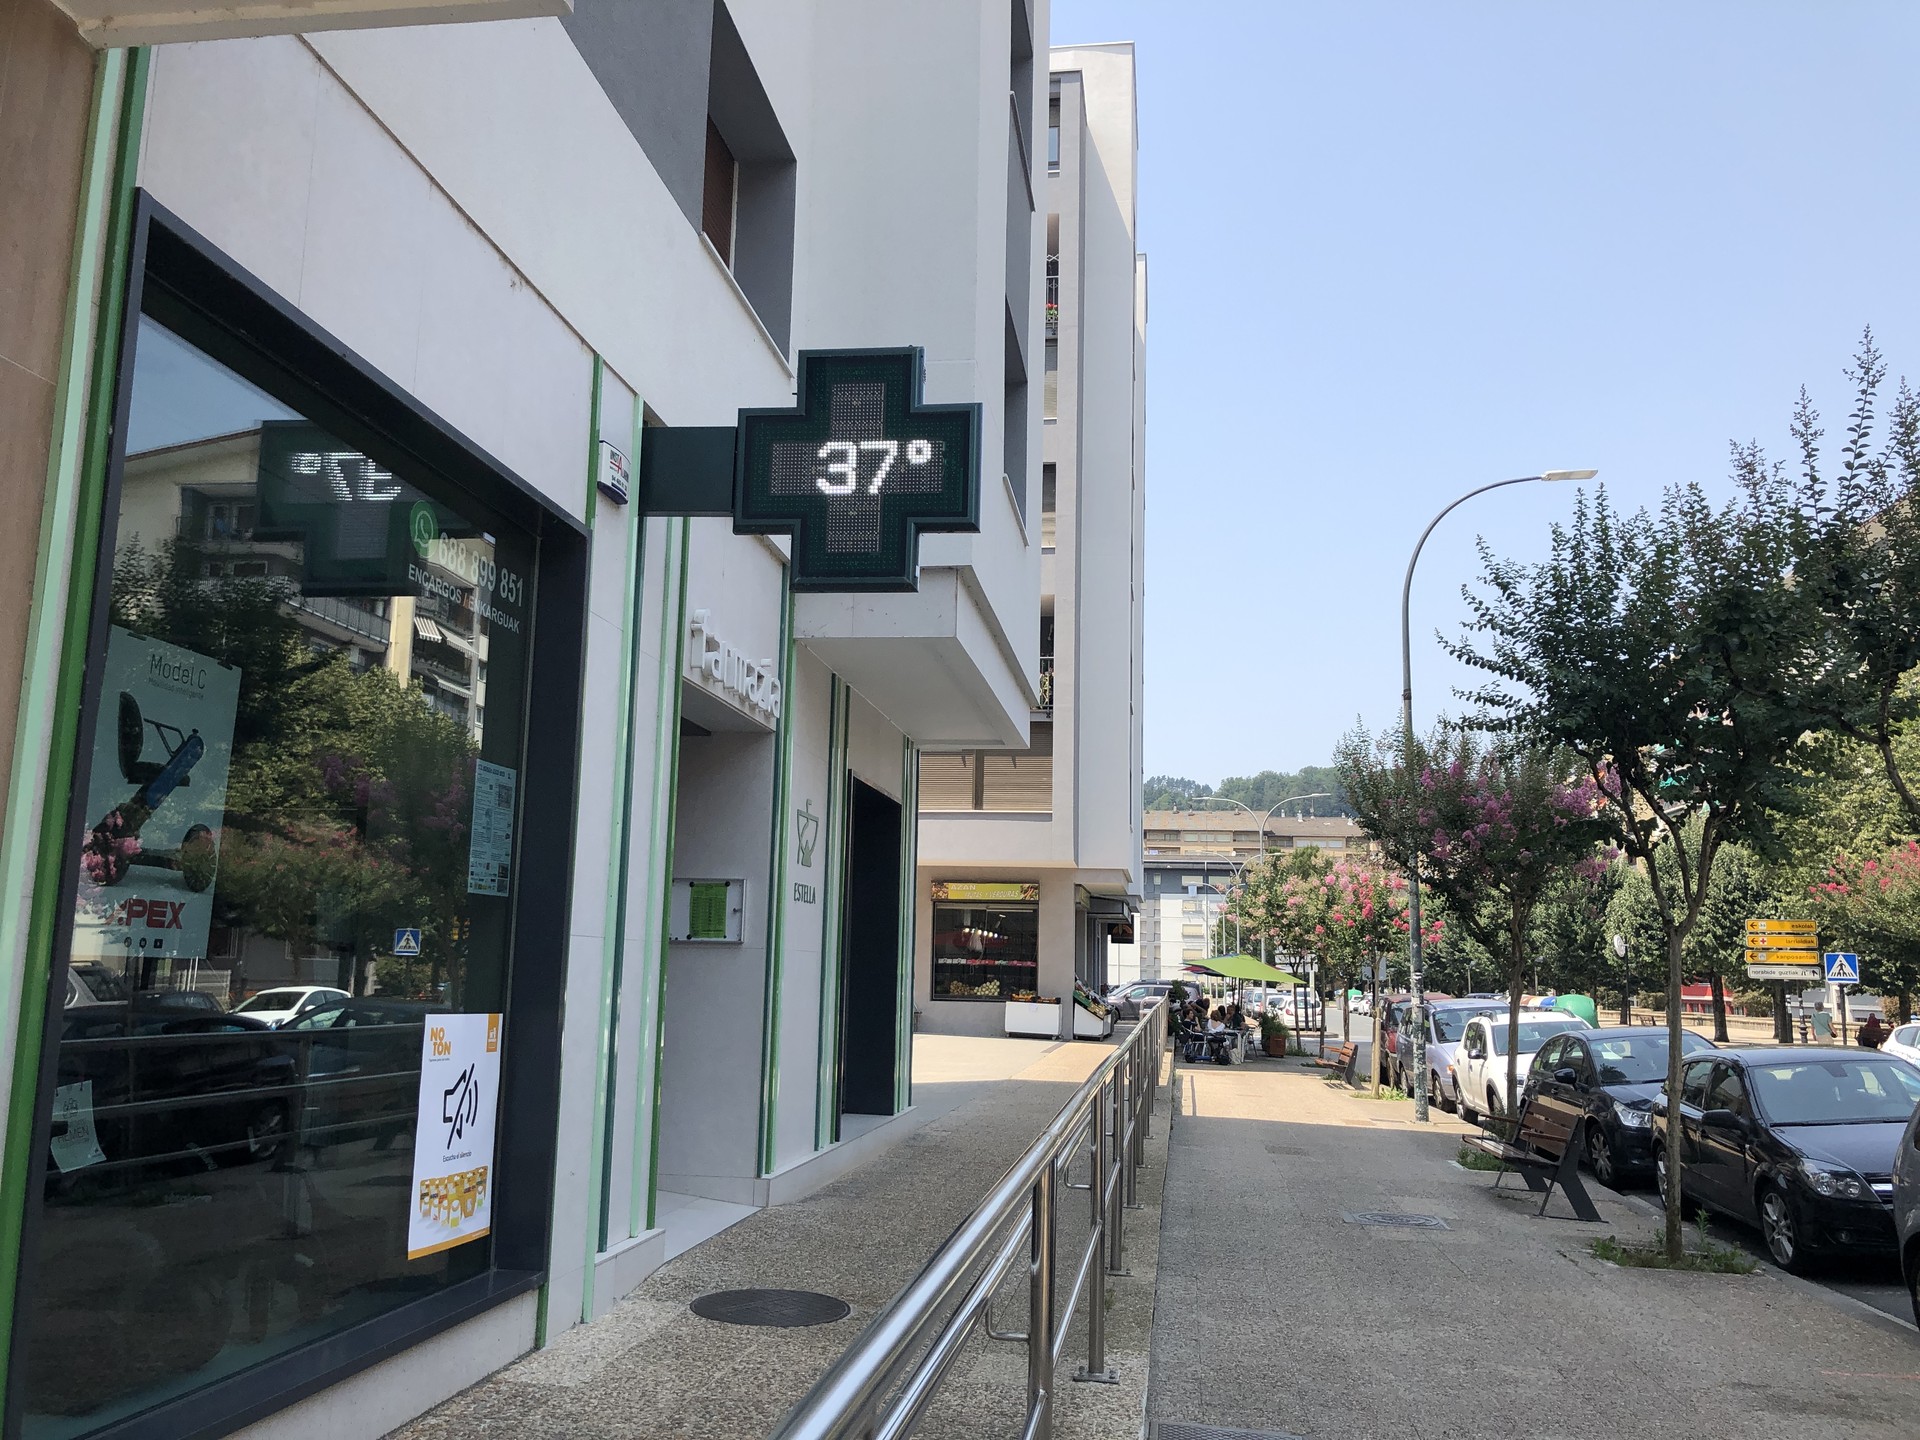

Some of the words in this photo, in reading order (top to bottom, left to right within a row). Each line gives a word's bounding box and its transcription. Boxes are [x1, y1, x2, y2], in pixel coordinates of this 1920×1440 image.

[816, 439, 932, 494] 37°
[438, 532, 467, 576] 688
[471, 550, 497, 592] 899
[500, 567, 524, 607] 851
[408, 563, 462, 604] ENCARGOS
[469, 595, 520, 634] ENKARGUAK
[150, 653, 195, 687] Model
[197, 669, 207, 690] C
[793, 882, 816, 904] ESTELLA
[430, 1027, 446, 1041] NO
